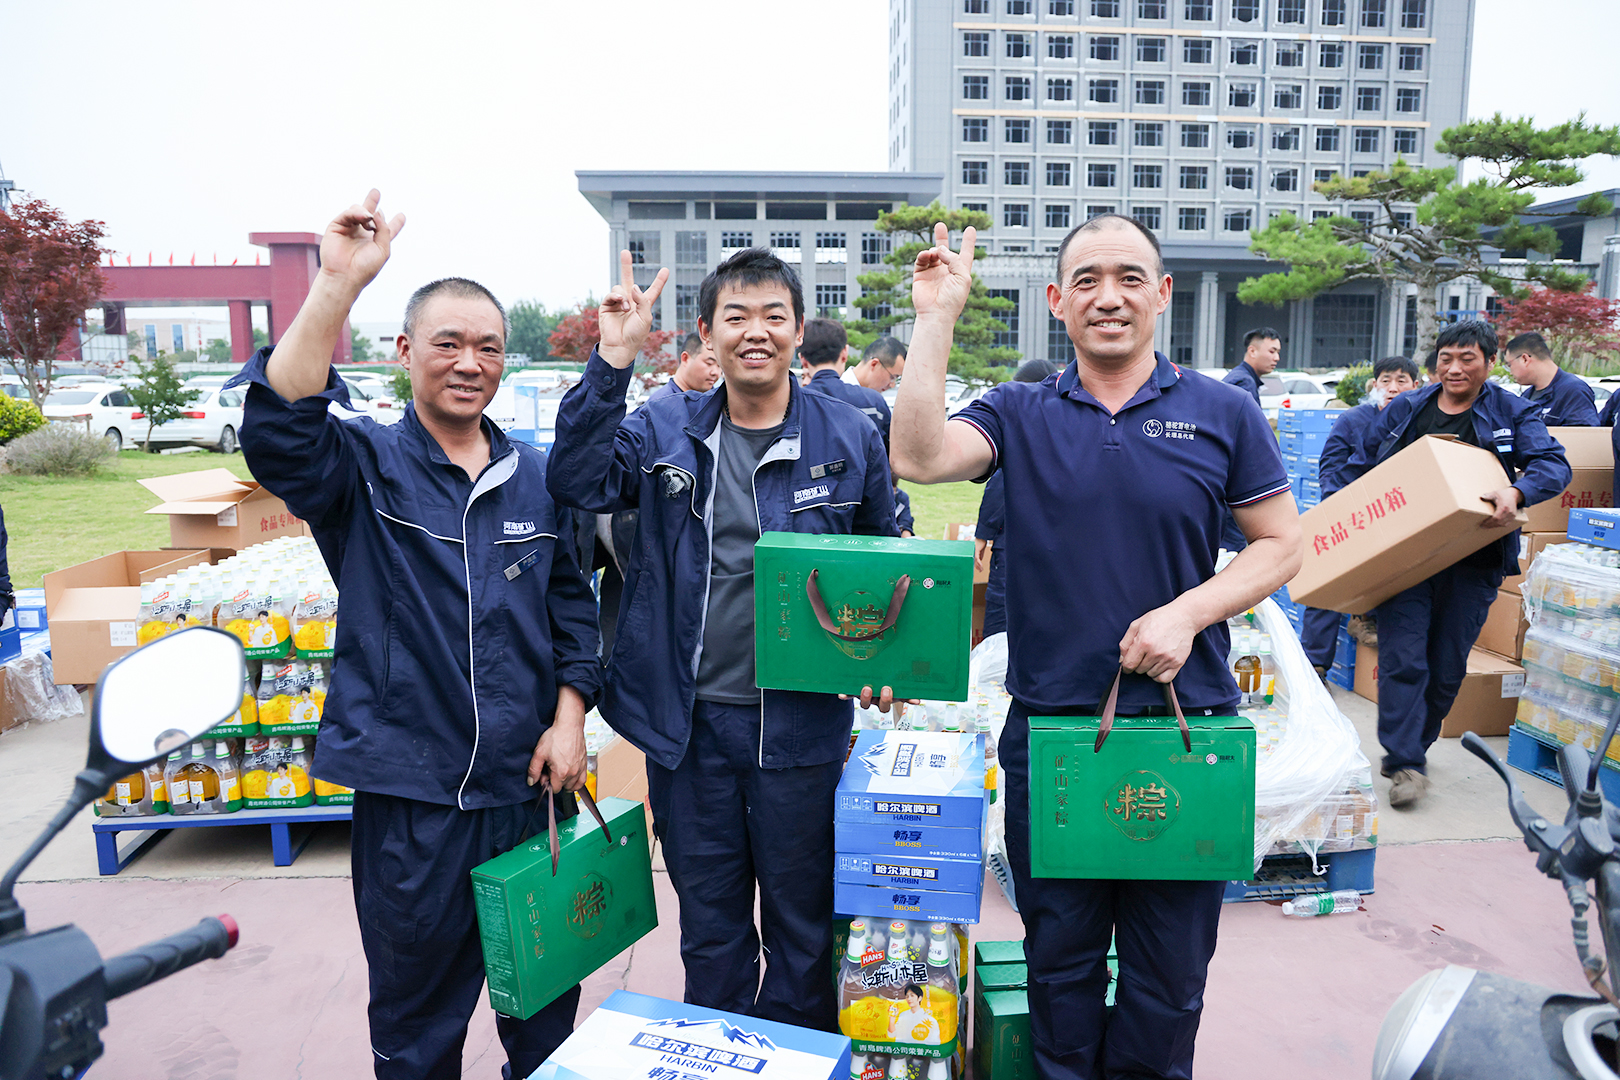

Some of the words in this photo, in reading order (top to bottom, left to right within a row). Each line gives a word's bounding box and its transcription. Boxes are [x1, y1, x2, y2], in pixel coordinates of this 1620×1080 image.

[1312, 486, 1407, 556] 食品专用箱
[1055, 754, 1069, 825] 矿山家粽
[877, 803, 938, 814] 哈尔滨啤酒
[1113, 783, 1168, 822] 粽
[894, 830, 922, 841] 畅享
[875, 864, 936, 878] 哈尔滨啤酒
[891, 876, 919, 885] HARBIN
[573, 881, 607, 926] 粽
[892, 894, 921, 905] 畅享
[862, 952, 883, 964] HANS
[861, 963, 928, 989] 汉斯小木屋
[637, 1034, 761, 1071] 哈尔滨啤酒
[859, 1044, 941, 1057] 青岛啤酒公司荣誉产品
[660, 1054, 718, 1073] HARBIN
[862, 1071, 883, 1080] HANS
